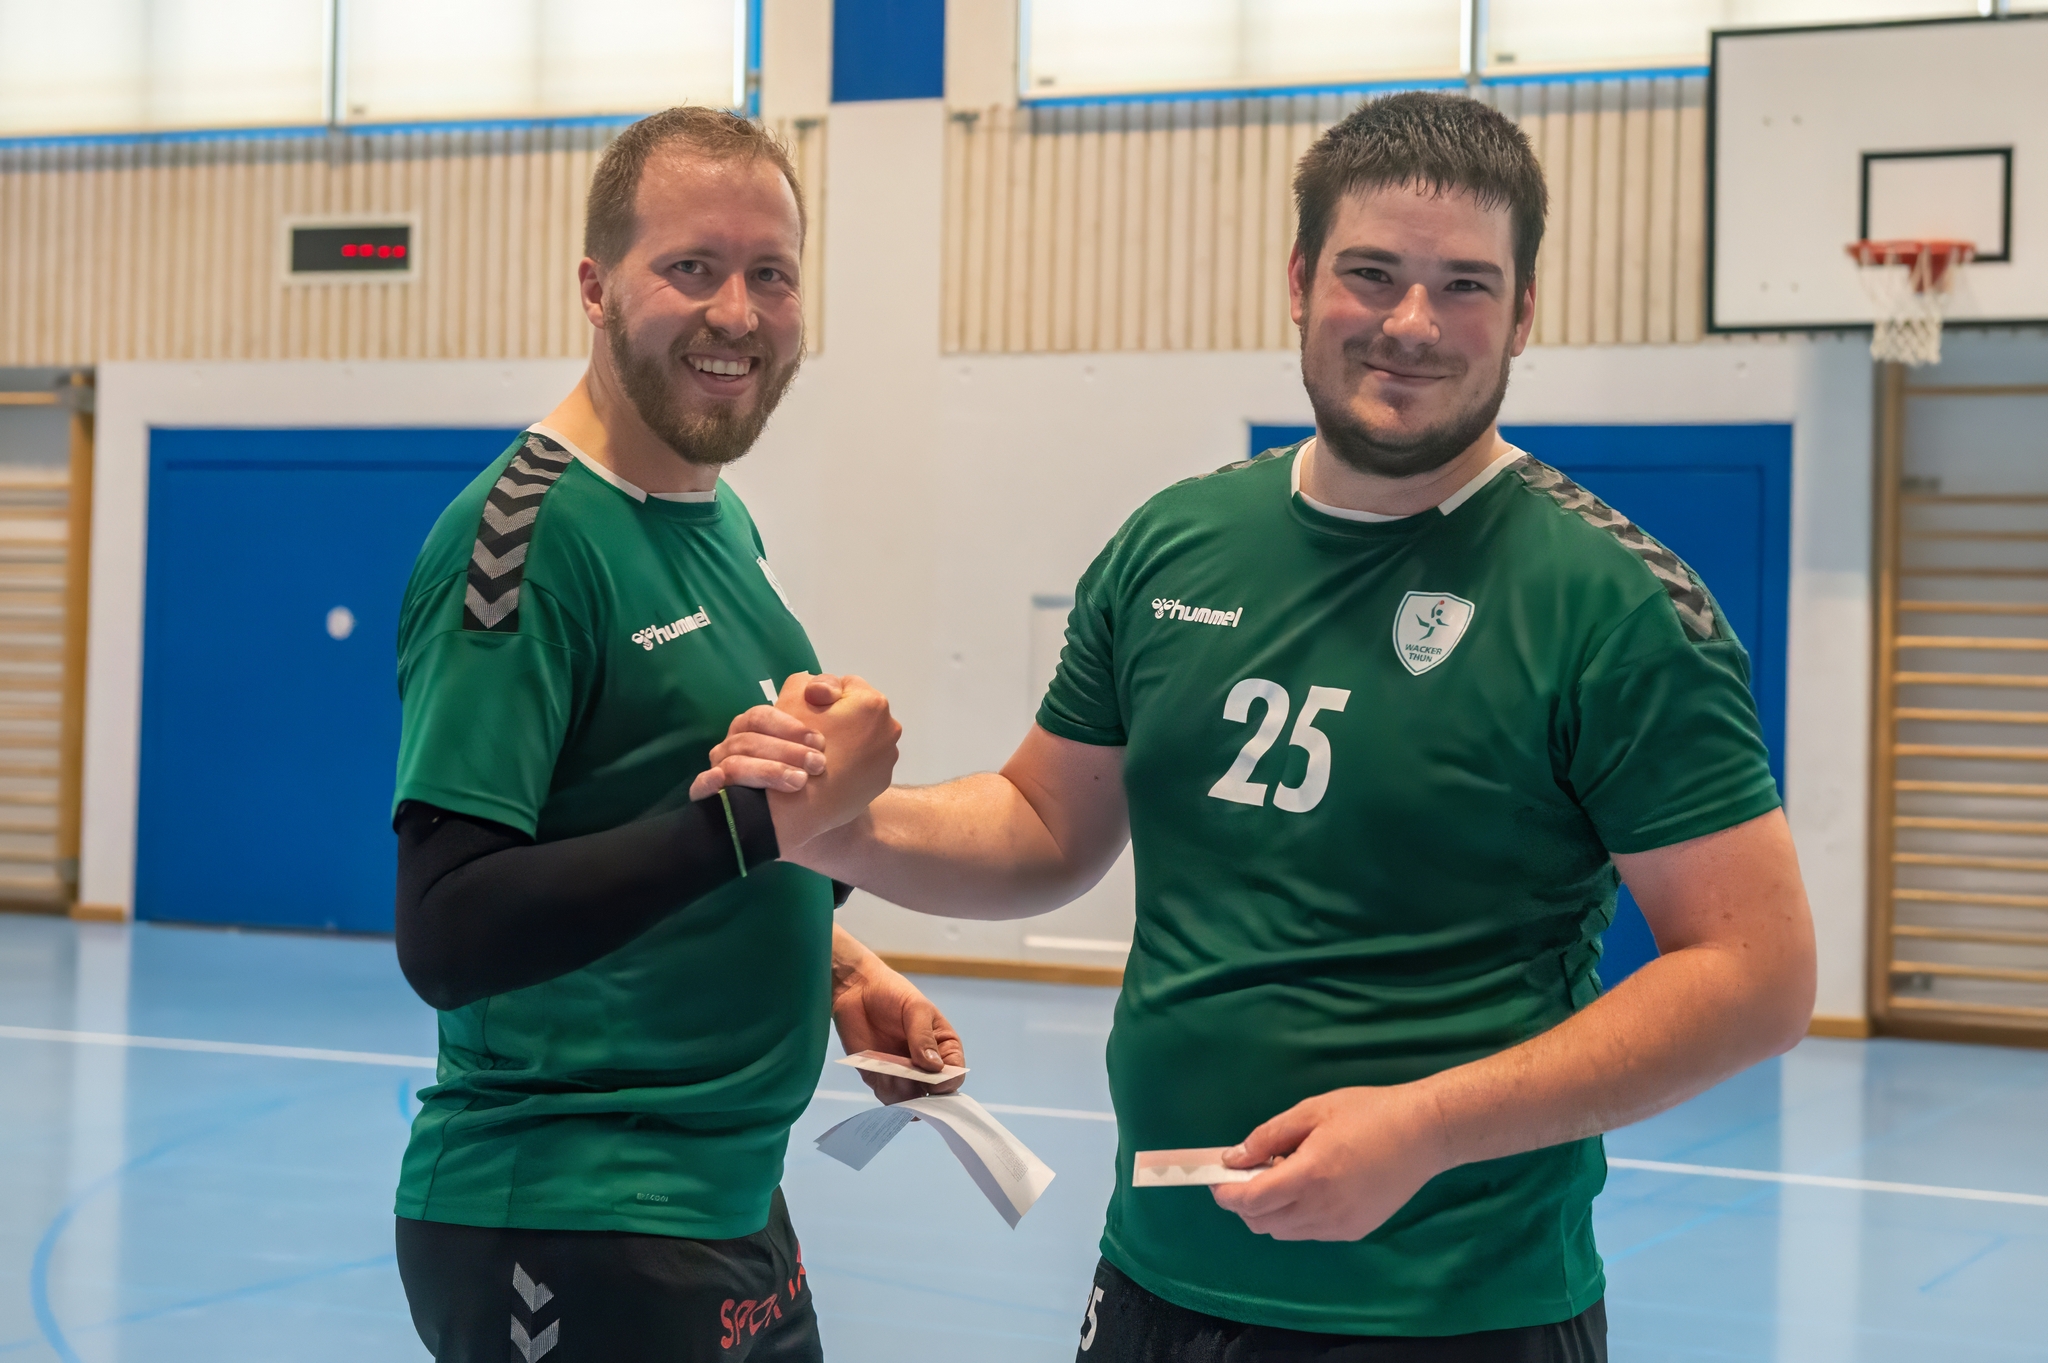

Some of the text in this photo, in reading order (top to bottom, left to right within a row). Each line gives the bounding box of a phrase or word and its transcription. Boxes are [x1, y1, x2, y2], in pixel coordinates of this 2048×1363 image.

[651, 605, 712, 645] hummel
[1169, 599, 1243, 628] hummel
[1405, 644, 1442, 655] WACKER
[1409, 652, 1433, 663] THUN
[1207, 678, 1351, 813] 25
[1081, 1286, 1105, 1351] 5
